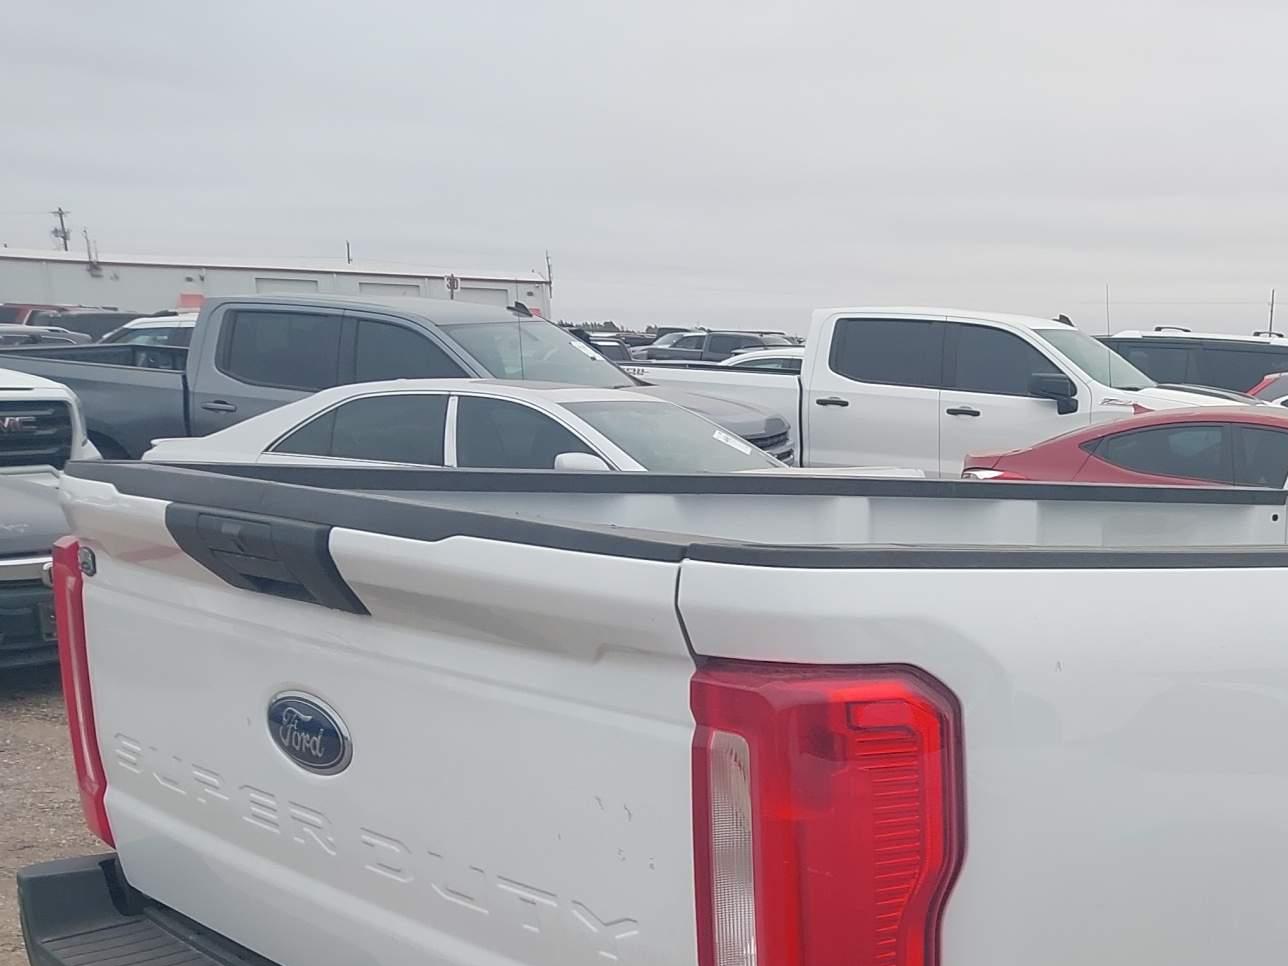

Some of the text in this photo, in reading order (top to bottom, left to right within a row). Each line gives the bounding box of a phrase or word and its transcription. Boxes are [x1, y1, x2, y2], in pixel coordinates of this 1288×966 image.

[0, 415, 38, 431] MC
[280, 706, 326, 758] Ford
[114, 732, 639, 961] SUPER DUTY
